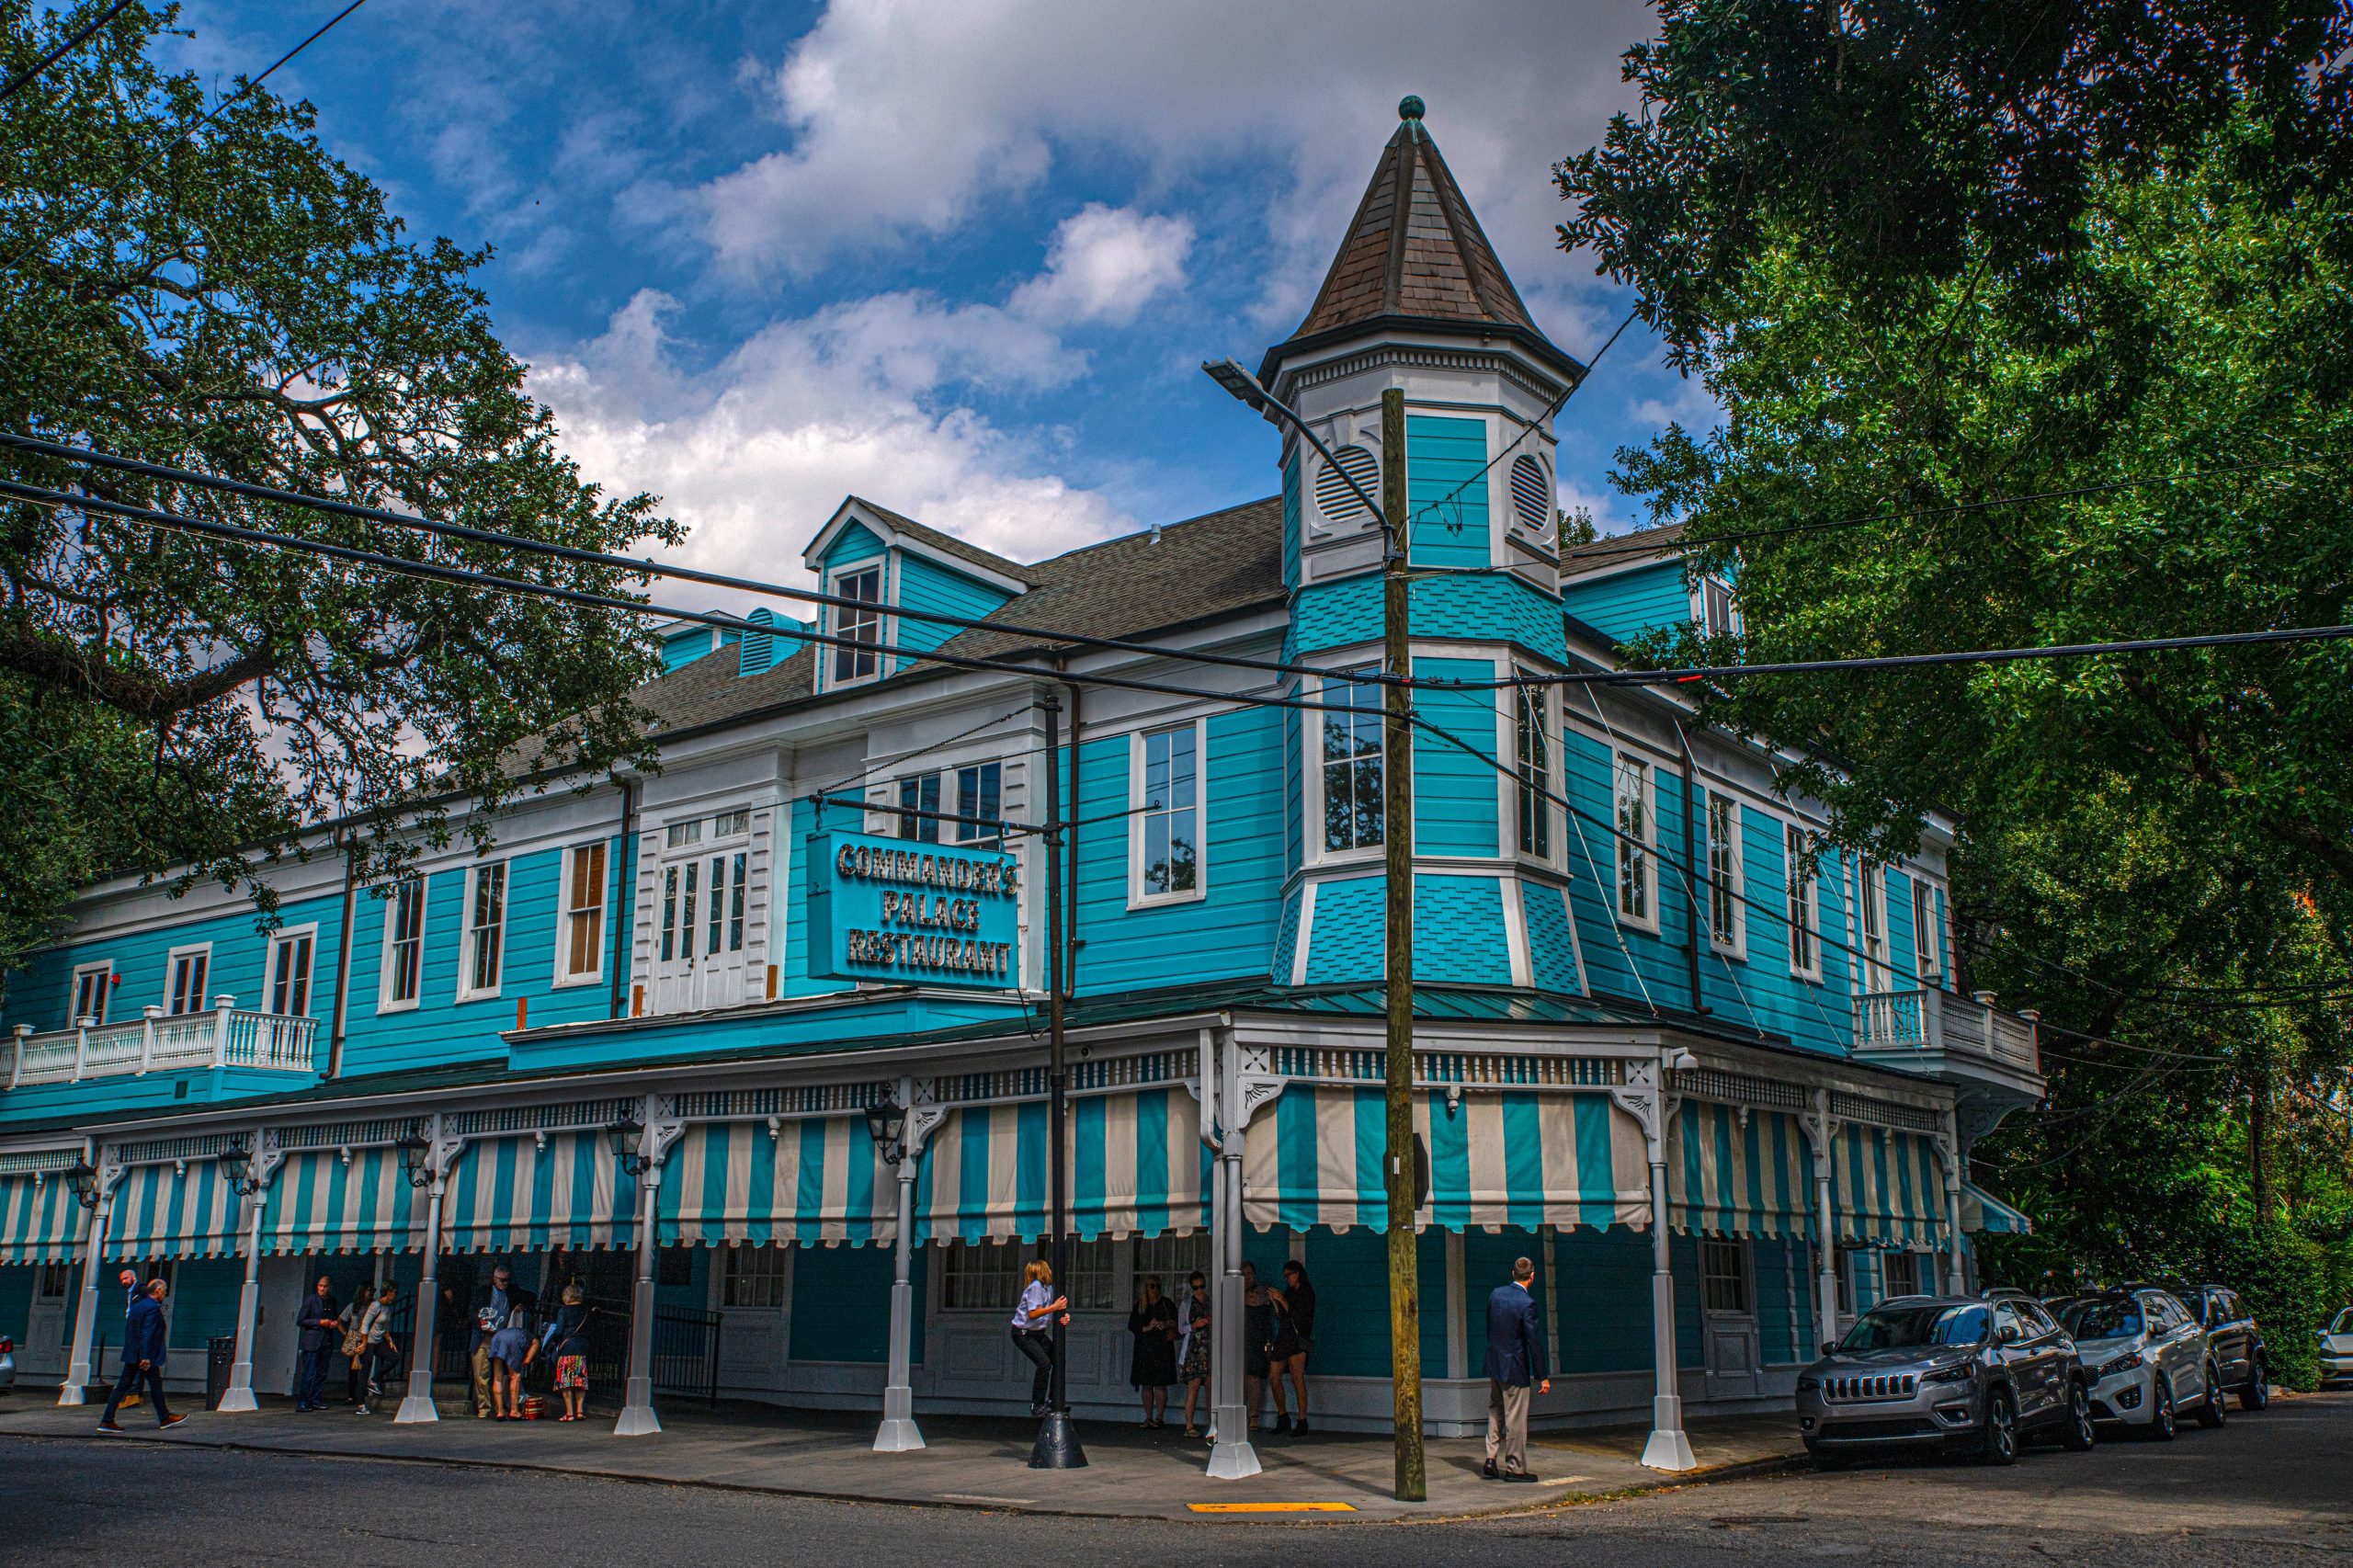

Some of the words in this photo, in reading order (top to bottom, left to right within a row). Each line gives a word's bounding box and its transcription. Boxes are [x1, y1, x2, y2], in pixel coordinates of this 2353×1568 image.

[838, 844, 1017, 895] COMMANDER'S
[883, 891, 980, 930] PALACE
[848, 929, 1011, 972] RESTAURANT
